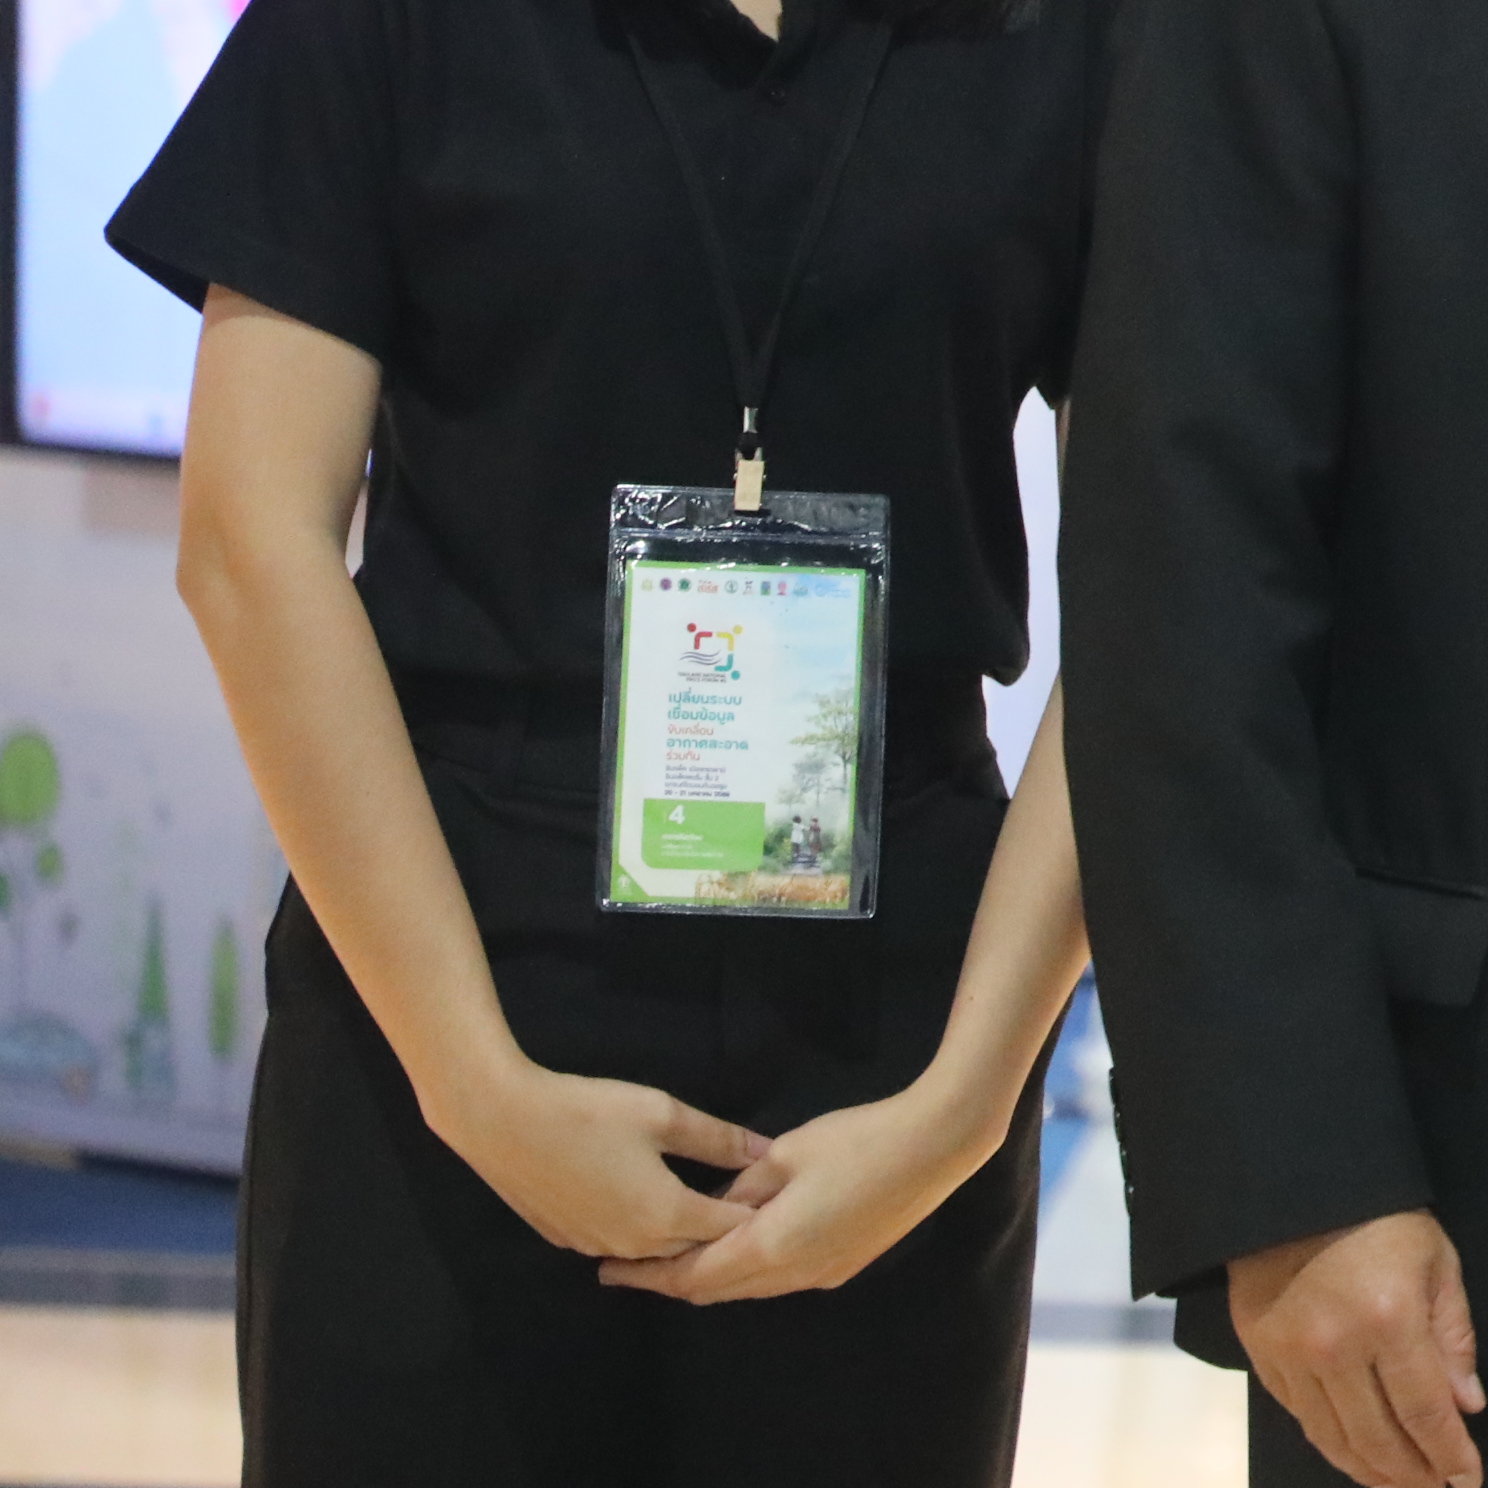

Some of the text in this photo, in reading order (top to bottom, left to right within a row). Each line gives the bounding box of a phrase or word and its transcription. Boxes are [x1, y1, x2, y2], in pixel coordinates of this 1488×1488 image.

[668, 687, 742, 705] เปลี่ยนระบบ
[668, 705, 735, 725] เชื่อมข้อมูล
[667, 738, 749, 750] อากาศสะอาด
[668, 804, 685, 825] 4
